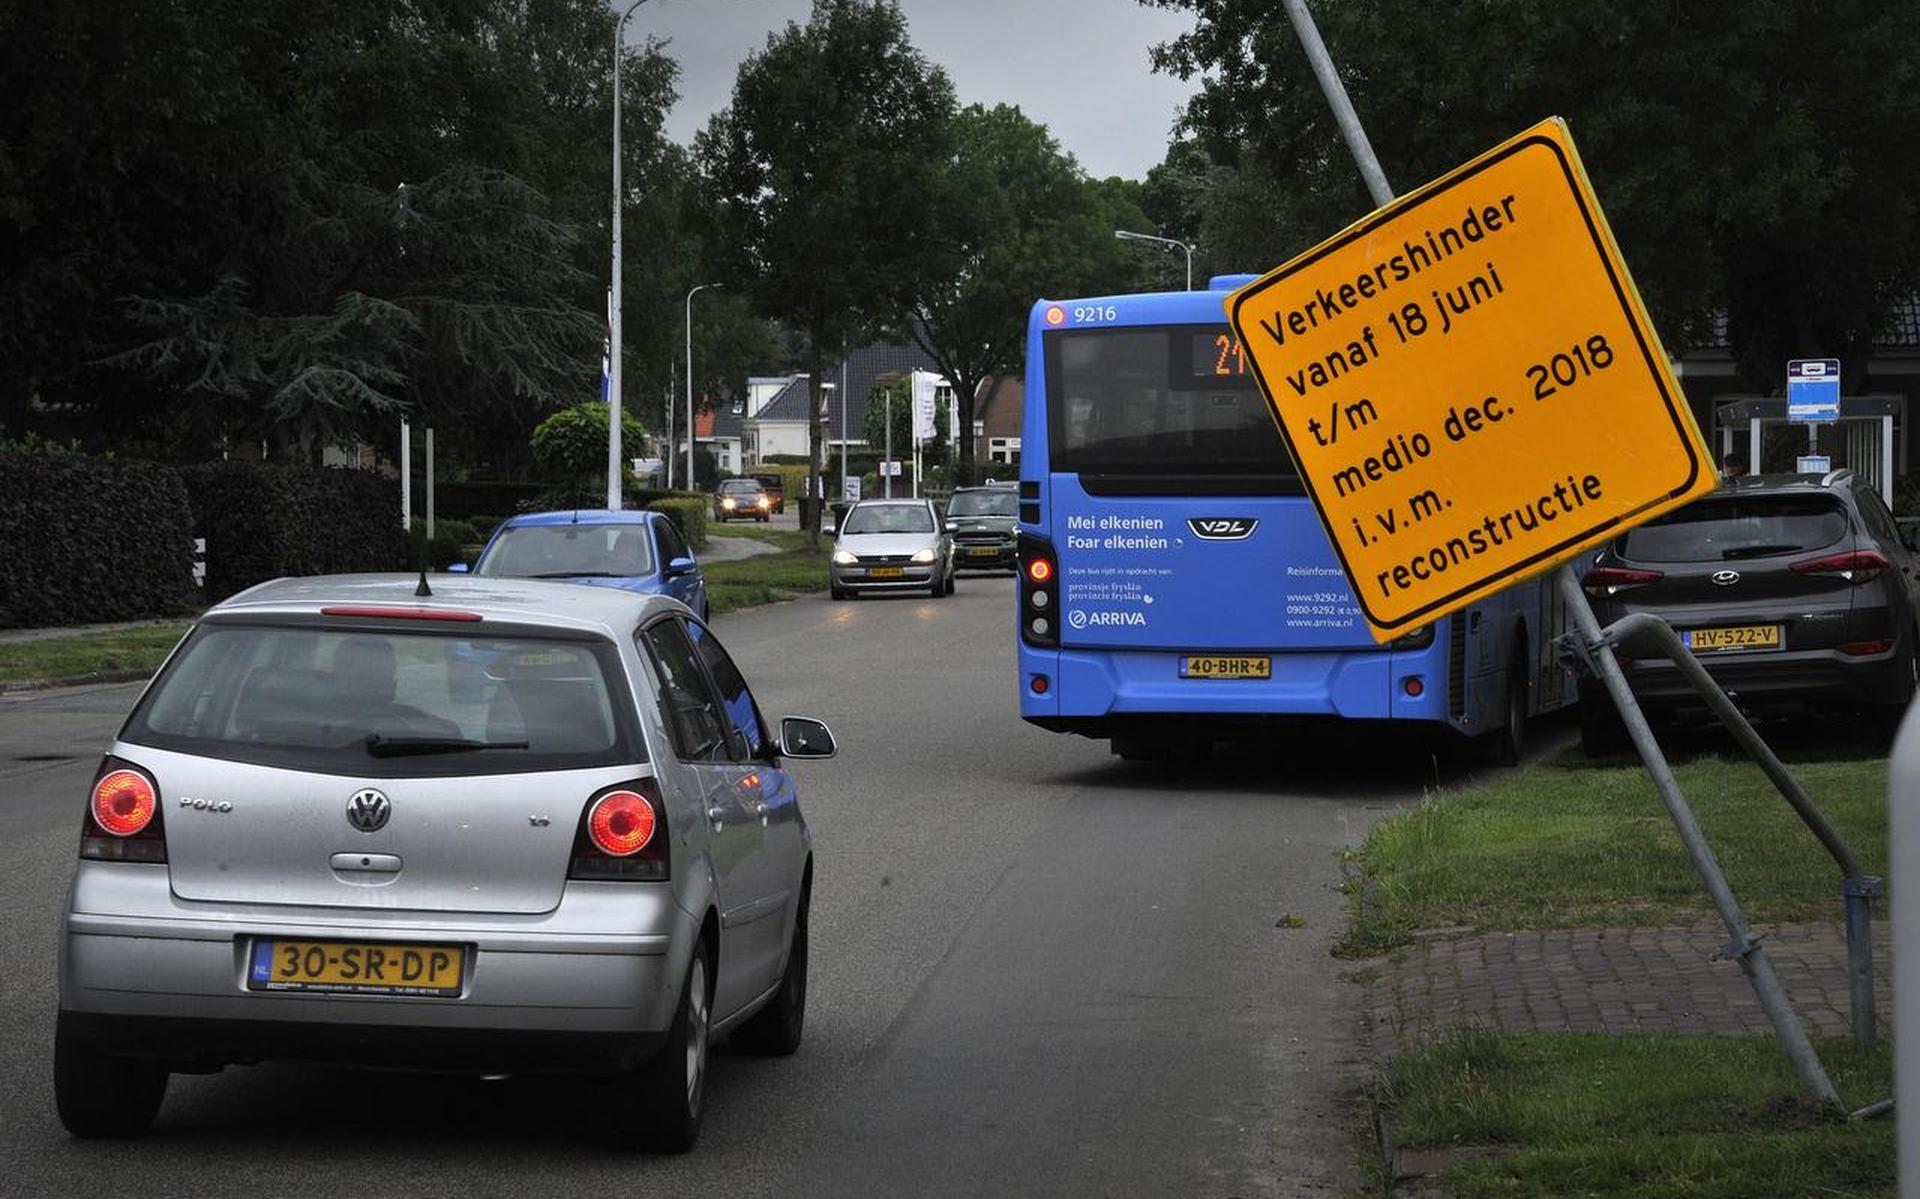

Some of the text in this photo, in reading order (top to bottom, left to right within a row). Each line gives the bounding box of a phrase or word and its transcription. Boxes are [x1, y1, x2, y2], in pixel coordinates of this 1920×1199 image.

[1260, 195, 1515, 346] Verkeershinder
[1074, 305, 1117, 323] 9216
[1286, 262, 1504, 396] vanaf 18 juni
[1308, 398, 1378, 447] t/m
[1332, 334, 1614, 498] medio dec. 2018
[1067, 515, 1164, 530] Mei elkenien
[1199, 520, 1246, 533] VDL
[1352, 489, 1452, 548] i.v.m.
[1067, 534, 1168, 550] Foar elkenien
[1377, 474, 1602, 598] reconstructie
[1286, 592, 1349, 602] www.9292.nl
[1286, 605, 1336, 615] 0900-9292
[1088, 612, 1146, 626] ARRIVA
[1286, 617, 1353, 628] www.arriva.nl
[1695, 627, 1773, 646] HV-522-V
[1191, 659, 1265, 674] 40-BHR-4
[179, 797, 234, 814] POLO
[254, 965, 269, 976] NL
[280, 945, 450, 982] 30-SR-DP
